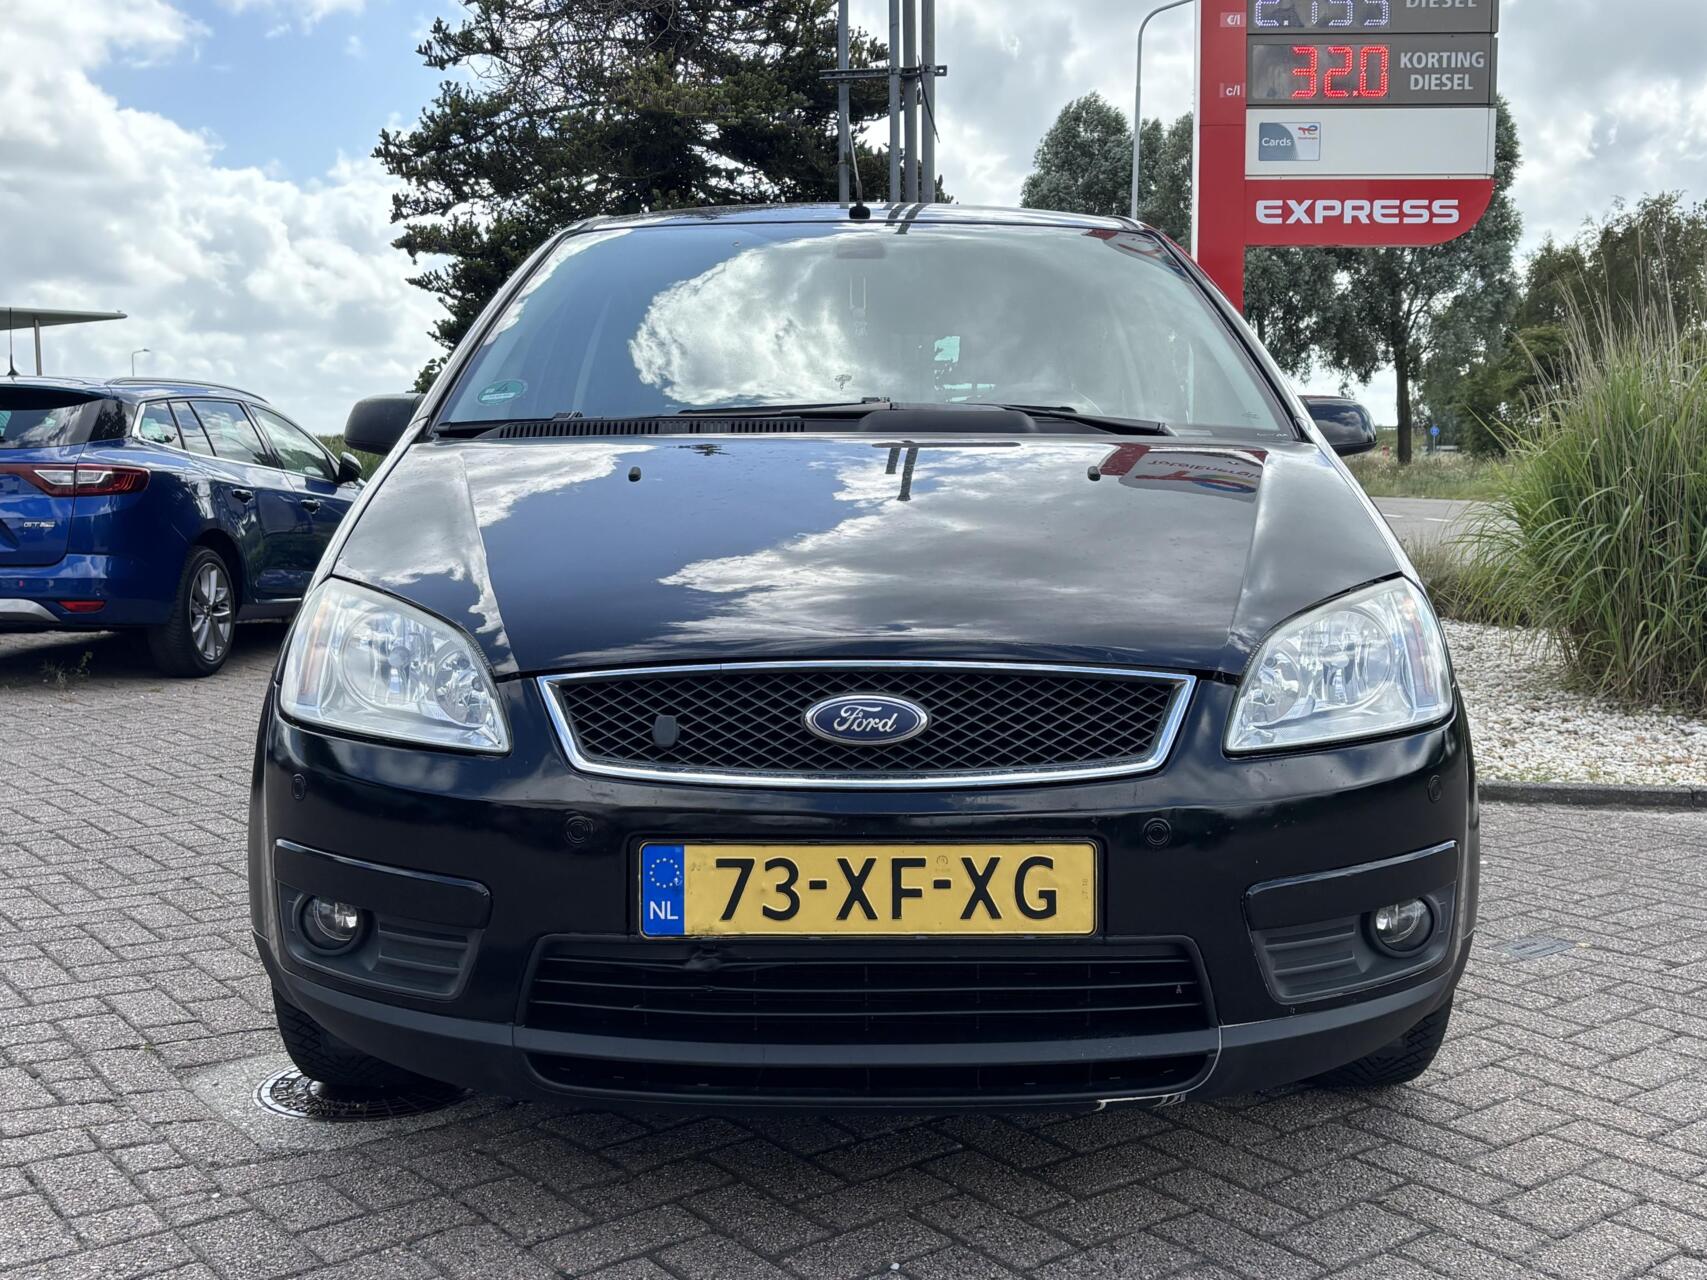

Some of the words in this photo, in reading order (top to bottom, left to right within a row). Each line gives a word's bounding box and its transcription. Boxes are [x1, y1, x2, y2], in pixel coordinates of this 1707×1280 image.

[1226, 14, 1241, 26] €/l
[1400, 51, 1484, 68] KORTING
[1292, 46, 1389, 98] 32.0
[1225, 85, 1241, 96] c/l
[1409, 74, 1474, 90] DIESEL
[1261, 137, 1292, 146] Cards
[1255, 199, 1460, 224] EXPRESS
[833, 704, 898, 732] Ford
[714, 855, 1057, 921] 73-XF-XG
[649, 901, 679, 920] NL
